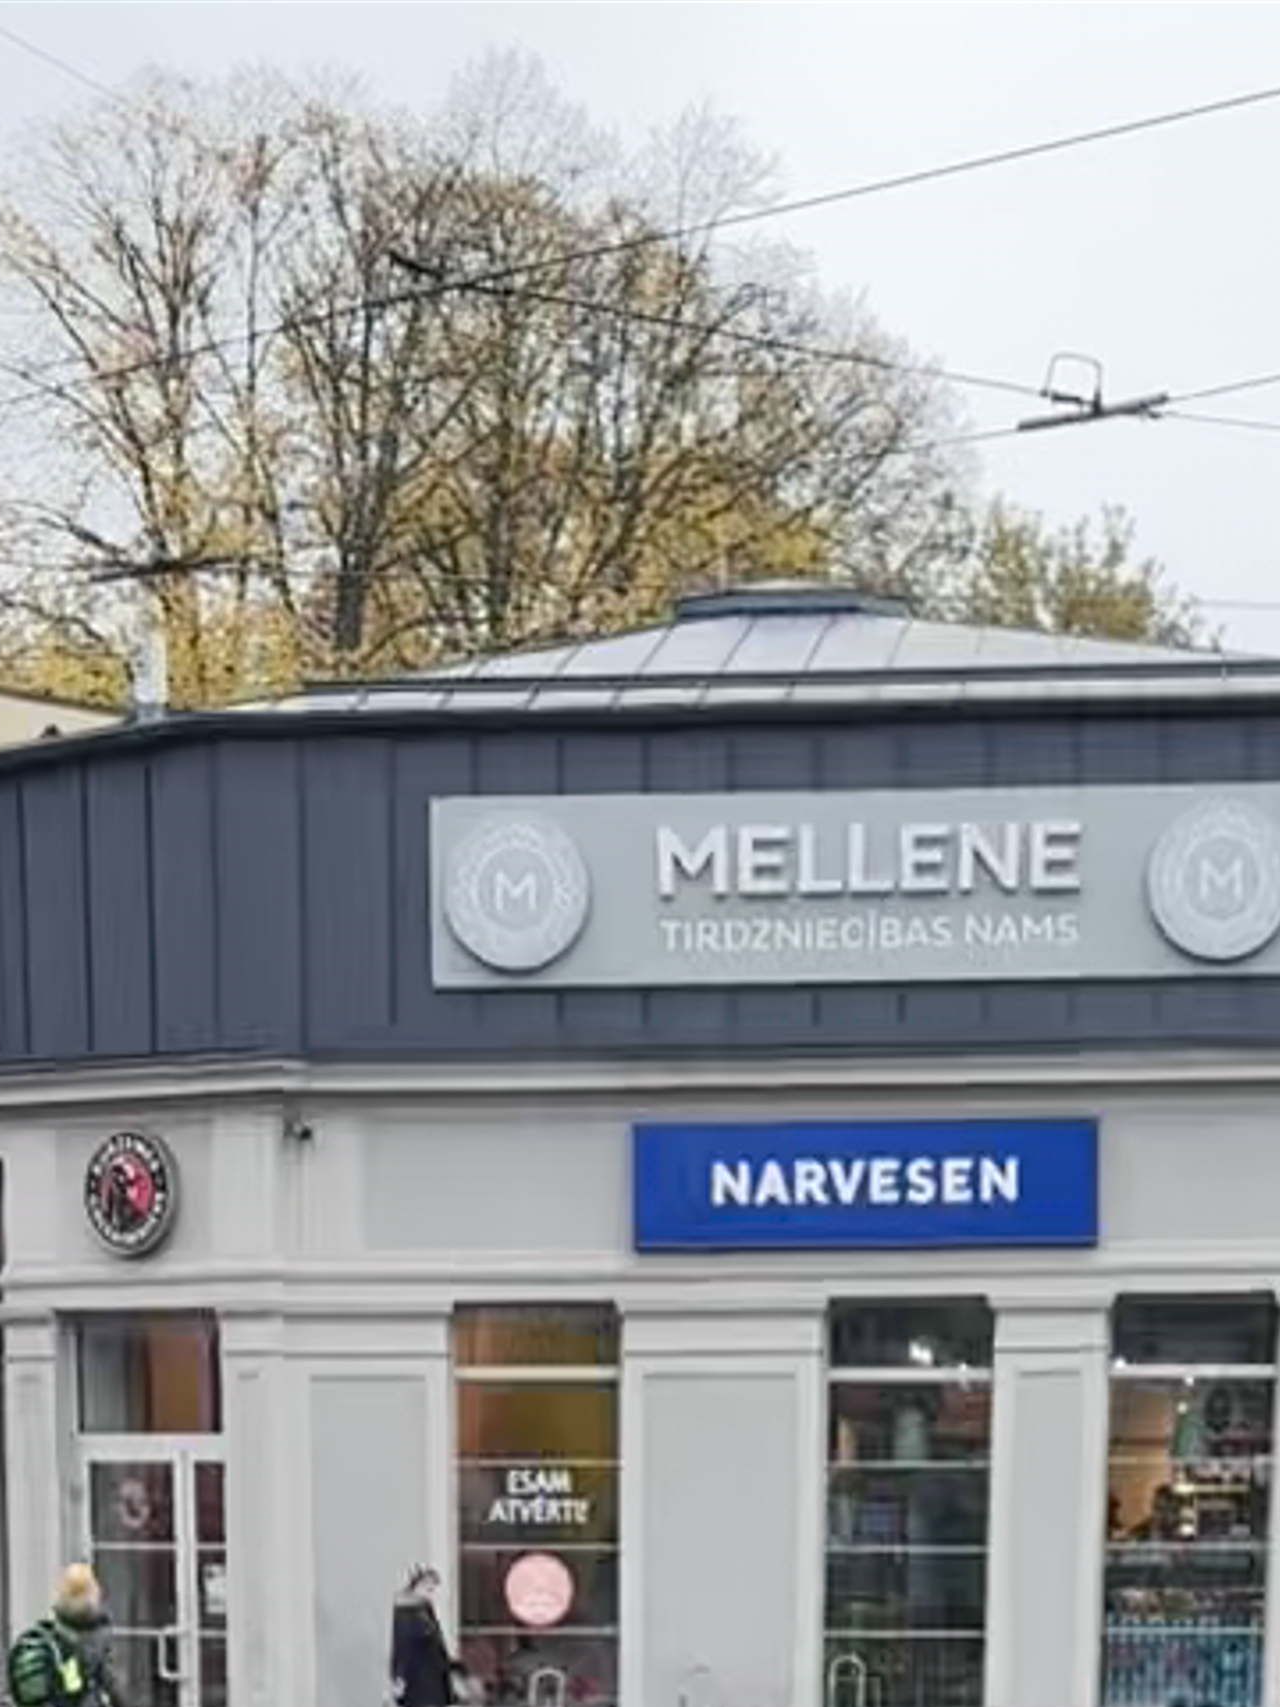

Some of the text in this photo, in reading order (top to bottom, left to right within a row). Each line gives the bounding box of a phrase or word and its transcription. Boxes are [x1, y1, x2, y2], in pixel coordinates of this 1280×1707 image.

[656, 822, 1081, 898] MELLENE
[1200, 858, 1243, 899] M
[495, 871, 537, 911] M
[659, 909, 1080, 952] TIRDZNIECĪBAS NAMS
[711, 1156, 1019, 1207] NARVESEN
[507, 1469, 572, 1494] ESAM
